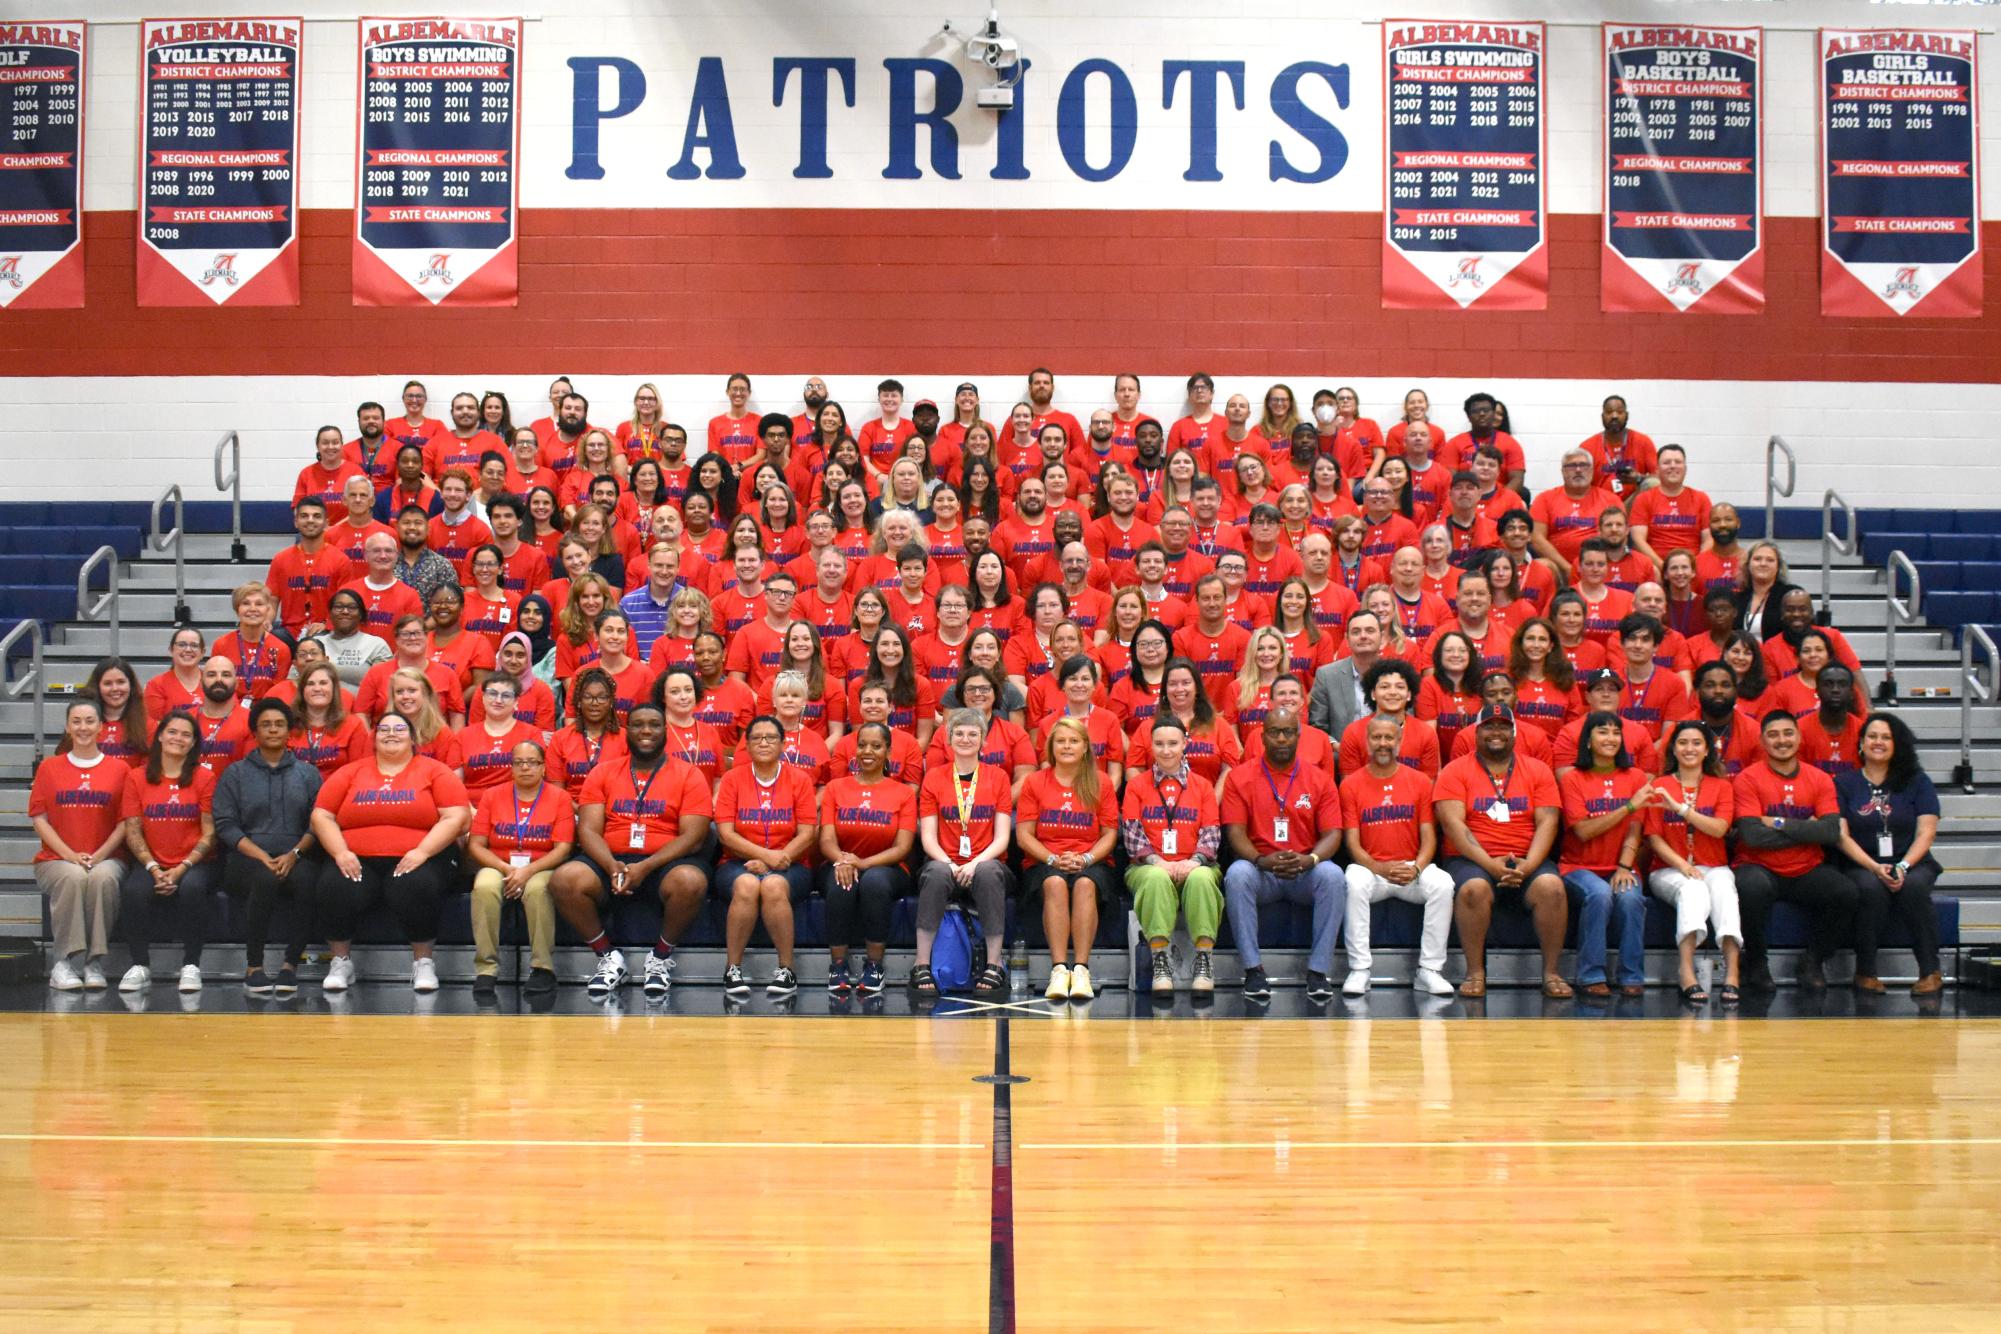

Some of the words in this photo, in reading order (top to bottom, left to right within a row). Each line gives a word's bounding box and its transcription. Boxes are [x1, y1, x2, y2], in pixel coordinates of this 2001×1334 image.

[148, 22, 297, 48] ALBEMARLE
[364, 20, 516, 48] ALBEMARLE
[1389, 24, 1540, 52] ALBEMARLE
[1609, 28, 1757, 58] ALBEMARLE
[1825, 33, 1972, 60] ALBEMARLE
[157, 48, 286, 63] VOLLEYBALL
[372, 48, 415, 63] BOYS
[418, 47, 507, 63] SWIMMING
[1396, 50, 1442, 66] GIRLS
[1444, 50, 1533, 67] SWIMMING
[1656, 51, 1711, 66] BOYS
[1872, 55, 1928, 70] GIRLS
[0, 69, 64, 81] CHAMPIONS
[161, 67, 210, 76] DISTRICT
[215, 66, 281, 76] CHAMPIONS
[378, 66, 427, 76] DISTRICT
[432, 66, 498, 75] CHAMPIONS
[1403, 69, 1452, 79] DISTRICT
[1457, 70, 1524, 80] CHAMPIONS
[1624, 65, 1741, 82] BASKETBALL
[1842, 69, 1957, 85] BASKETBALL
[15, 86, 37, 95] 1997
[51, 85, 75, 94] 1999
[370, 82, 396, 92] 2004
[405, 82, 432, 92] 2005
[445, 82, 472, 92] 2006
[483, 82, 509, 92] 2007
[1395, 84, 1422, 94] 2002
[1430, 86, 1457, 96] 2004
[1471, 87, 1498, 97] 2005
[1508, 86, 1536, 97] 2006
[1622, 83, 1671, 94] DISTRICT
[1675, 83, 1742, 95] CHAMPIONS
[1840, 87, 1887, 97] DISTRICT
[1892, 89, 1958, 98] CHAMPIONS
[13, 101, 38, 110] 2004
[49, 100, 75, 109] 2005
[370, 97, 396, 107] 2008
[405, 97, 431, 107] 2010
[445, 97, 468, 107] 2011
[482, 97, 508, 107] 2012
[1395, 99, 1421, 109] 2007
[1431, 100, 1456, 111] 2012
[1471, 101, 1496, 111] 2013
[1509, 101, 1534, 111] 2015
[1615, 98, 1639, 109] 1977
[1649, 100, 1676, 111] 1978
[1691, 100, 1714, 111] 1981
[1725, 101, 1751, 112] 1985
[1833, 103, 1858, 113] 1994
[1869, 104, 1892, 114] 1995
[1908, 104, 1932, 114] 1996
[1943, 105, 1966, 115] 1998
[13, 115, 38, 125] 2008
[49, 115, 74, 124] 2010
[153, 112, 178, 122] 2013
[188, 112, 214, 122] 2015
[230, 111, 253, 121] 2017
[263, 111, 288, 120] 2018
[370, 111, 394, 121] 2013
[404, 112, 429, 122] 2015
[445, 112, 470, 122] 2016
[482, 112, 507, 122] 2017
[564, 56, 1352, 184] PATRIOTS
[1395, 114, 1421, 124] 2016
[1431, 114, 1456, 125] 2017
[1471, 116, 1497, 125] 2018
[1509, 116, 1534, 126] 2019
[1613, 112, 1641, 123] 2002
[1648, 114, 1677, 125] 2003
[1689, 115, 1717, 126] 2005
[1724, 116, 1751, 127] 2007
[1832, 118, 1859, 128] 2002
[1868, 118, 1891, 128] 2013
[1906, 119, 1932, 128] 2015
[13, 129, 36, 140] 2017
[153, 126, 178, 136] 2019
[188, 127, 215, 136] 2020
[1613, 127, 1640, 138] 2016
[1648, 128, 1674, 140] 2017
[1688, 129, 1715, 140] 2018
[4, 156, 63, 166] CHAMPIONS
[162, 155, 215, 163] REGIONAL
[219, 154, 279, 163] CHAMPIONS
[379, 153, 431, 163] REGIONAL
[435, 154, 497, 163] CHAMPIONS
[1405, 155, 1458, 165] REGIONAL
[1463, 156, 1525, 166] CHAMPIONS
[1623, 158, 1676, 169] REGIONAL
[1680, 159, 1742, 171] CHAMPIONS
[1843, 164, 1893, 173] REGIONAL
[1898, 165, 1959, 174] CHAMPIONS
[153, 171, 177, 181] 1989
[189, 171, 213, 181] 1996
[229, 171, 253, 181] 1999
[263, 170, 289, 180] 2000
[368, 171, 394, 181] 2008
[403, 171, 430, 181] 2009
[444, 171, 469, 181] 2010
[481, 172, 507, 181] 2012
[1395, 172, 1422, 182] 2002
[1431, 172, 1458, 182] 2004
[1472, 172, 1497, 183] 2012
[1509, 173, 1534, 183] 2014
[1614, 176, 1639, 186] 2018
[151, 185, 179, 195] 2008
[188, 186, 214, 195] 2020
[368, 186, 393, 196] 2018
[402, 185, 428, 196] 2019
[443, 186, 468, 196] 2021
[1395, 187, 1420, 197] 2015
[1431, 186, 1456, 197] 2021
[1472, 186, 1499, 197] 2022
[174, 211, 205, 220] STATE
[209, 210, 273, 220] CHAMPIONS
[390, 210, 420, 219] STATE
[425, 210, 490, 220] CHAMPIONS
[1417, 214, 1449, 223] STATE
[1454, 214, 1519, 223] CHAMPIONS
[1635, 215, 1669, 226] STATE
[1672, 216, 1736, 228] CHAMPIONS
[1856, 221, 1884, 230] STATE
[1889, 221, 1954, 230] CHAMPIONS
[151, 228, 179, 239] 2008
[1395, 228, 1420, 238] 2014
[1430, 229, 1456, 239] 2015
[1493, 705, 1501, 715] B
[1516, 702, 1565, 716] ALBEMARLE
[55, 790, 112, 804] ALBEMARLE
[355, 790, 415, 802] ALBEMARLE
[144, 804, 201, 817] ALBEMARLE
[739, 808, 792, 821] ALBEMARLE
[1362, 805, 1415, 822] ALBEMARLE
[838, 808, 893, 825] ALBEMARLE
[1040, 810, 1092, 826] ALBEMARLE
